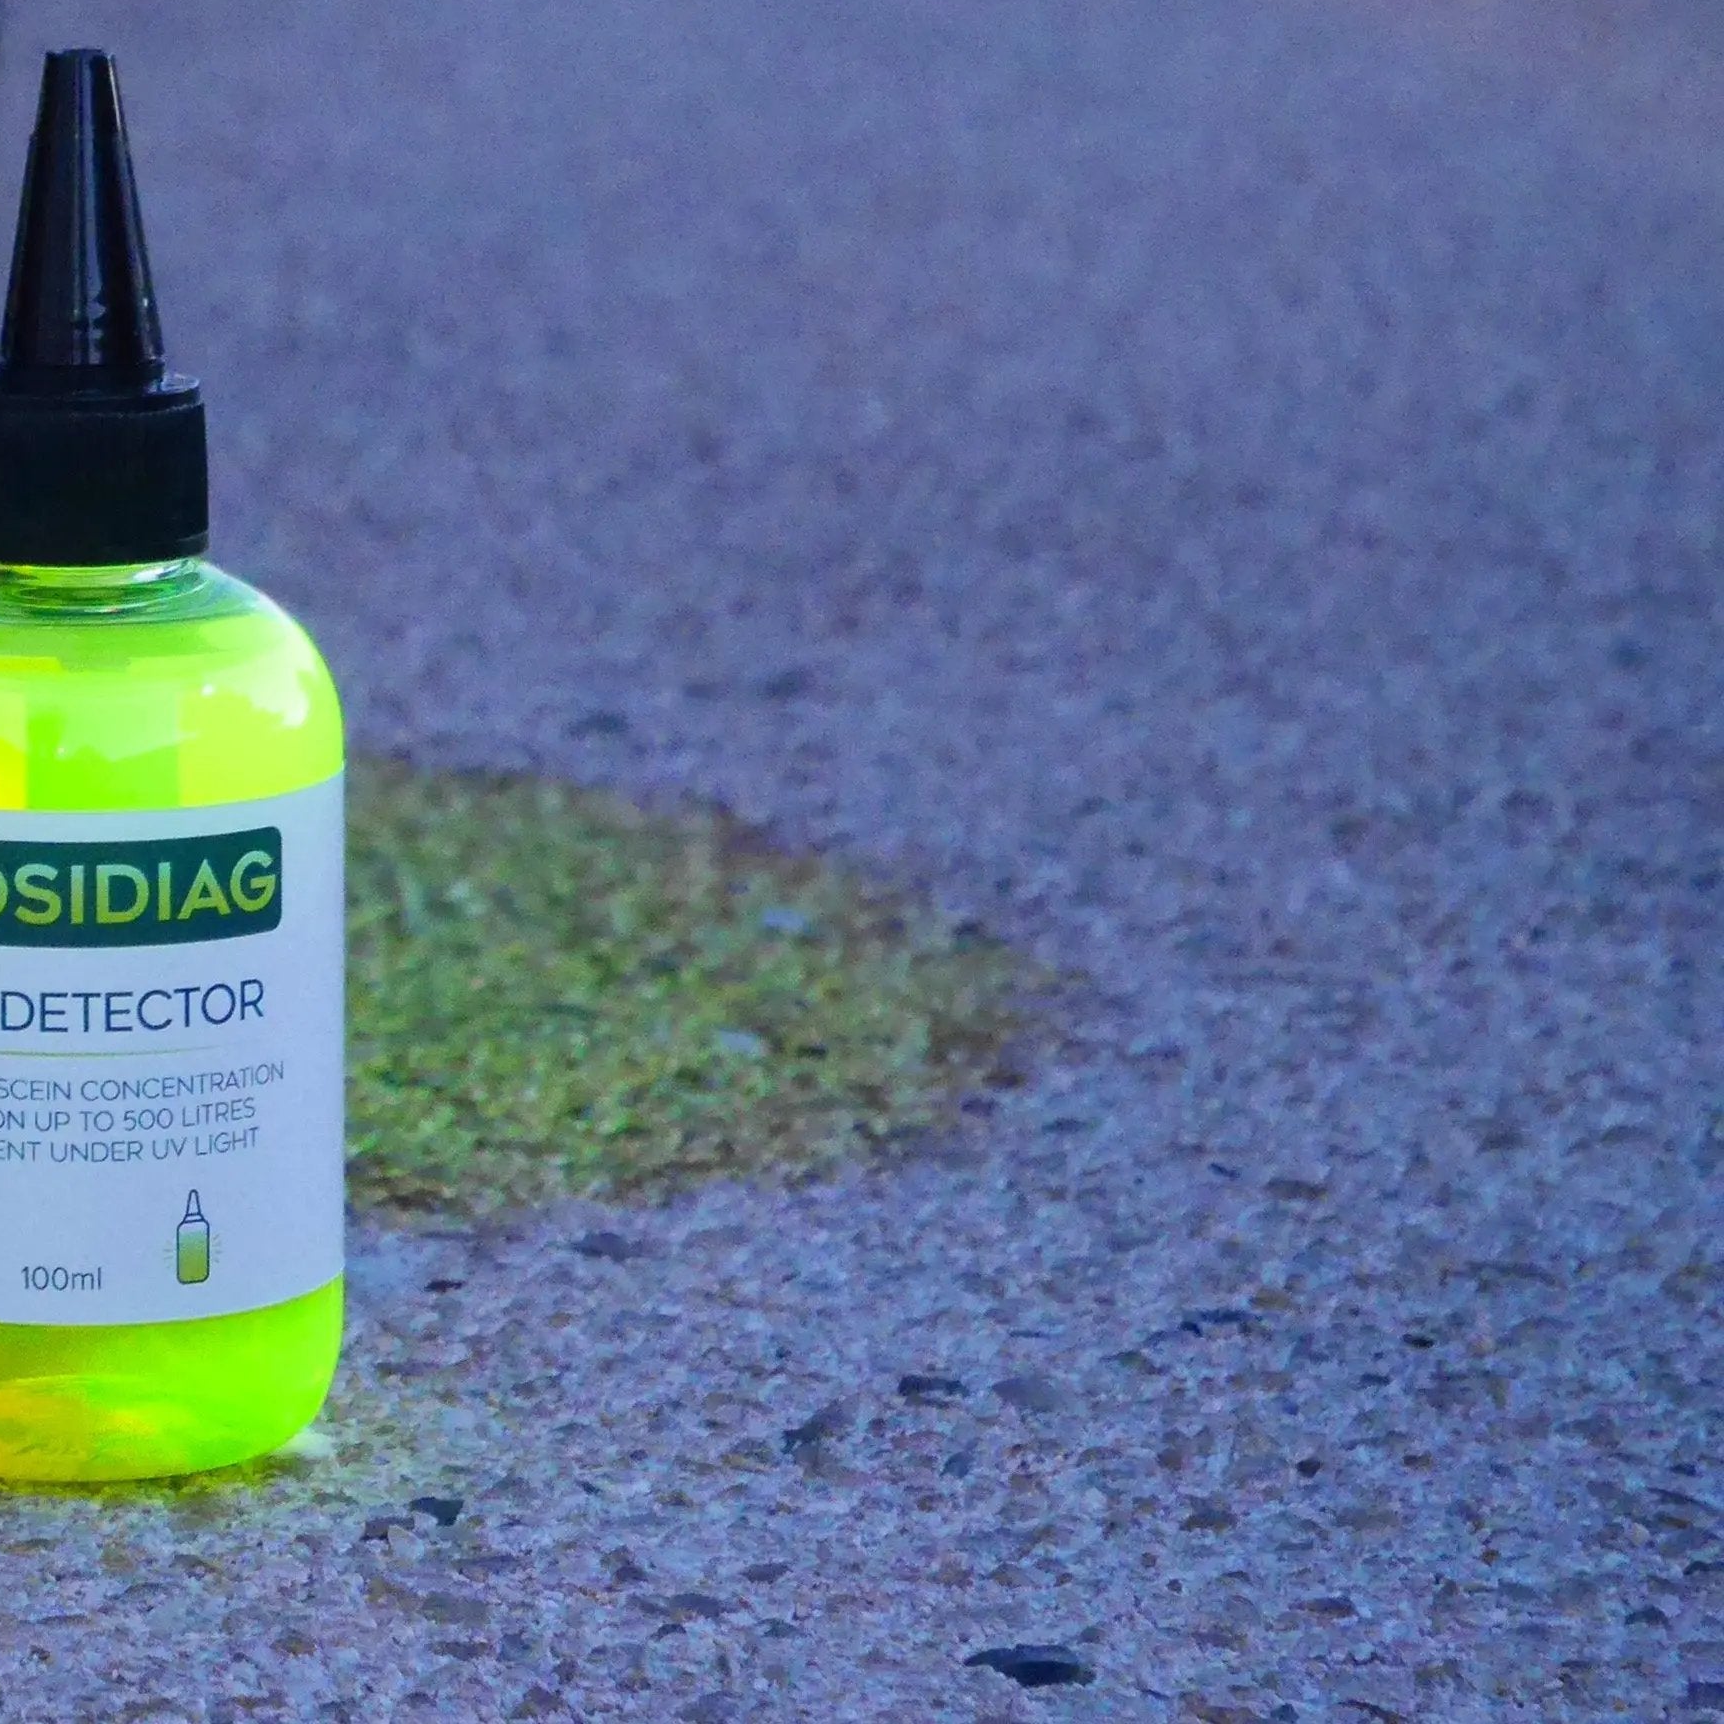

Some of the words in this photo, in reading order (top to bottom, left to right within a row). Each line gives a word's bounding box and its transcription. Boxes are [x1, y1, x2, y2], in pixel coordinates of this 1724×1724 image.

[1, 979, 265, 1033] DETECTOR
[80, 1061, 284, 1101] CONCENTRATION
[35, 1111, 70, 1131] UP
[79, 1110, 114, 1131] TO
[123, 1108, 174, 1130] 500
[182, 1097, 256, 1126] LITRES
[50, 1141, 142, 1162] UNDER
[152, 1137, 186, 1160] UV
[195, 1126, 259, 1157] LIGHT
[21, 1266, 102, 1291] 100ml
